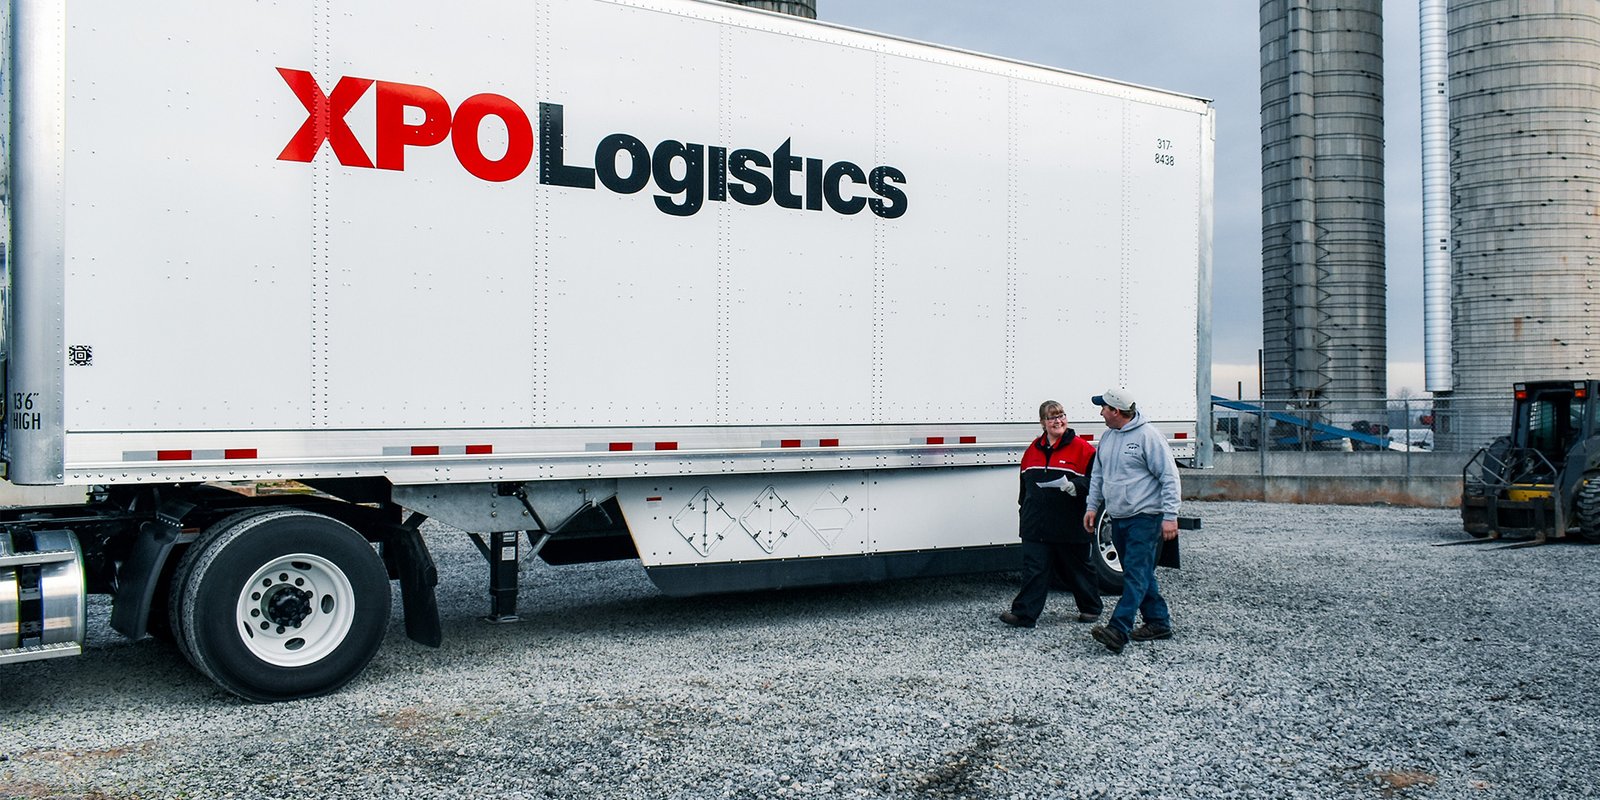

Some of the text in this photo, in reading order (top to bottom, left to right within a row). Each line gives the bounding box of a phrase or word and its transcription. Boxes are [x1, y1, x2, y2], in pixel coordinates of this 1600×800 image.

[277, 67, 908, 220] XPO Logistics
[13, 412, 41, 430] HIGH
